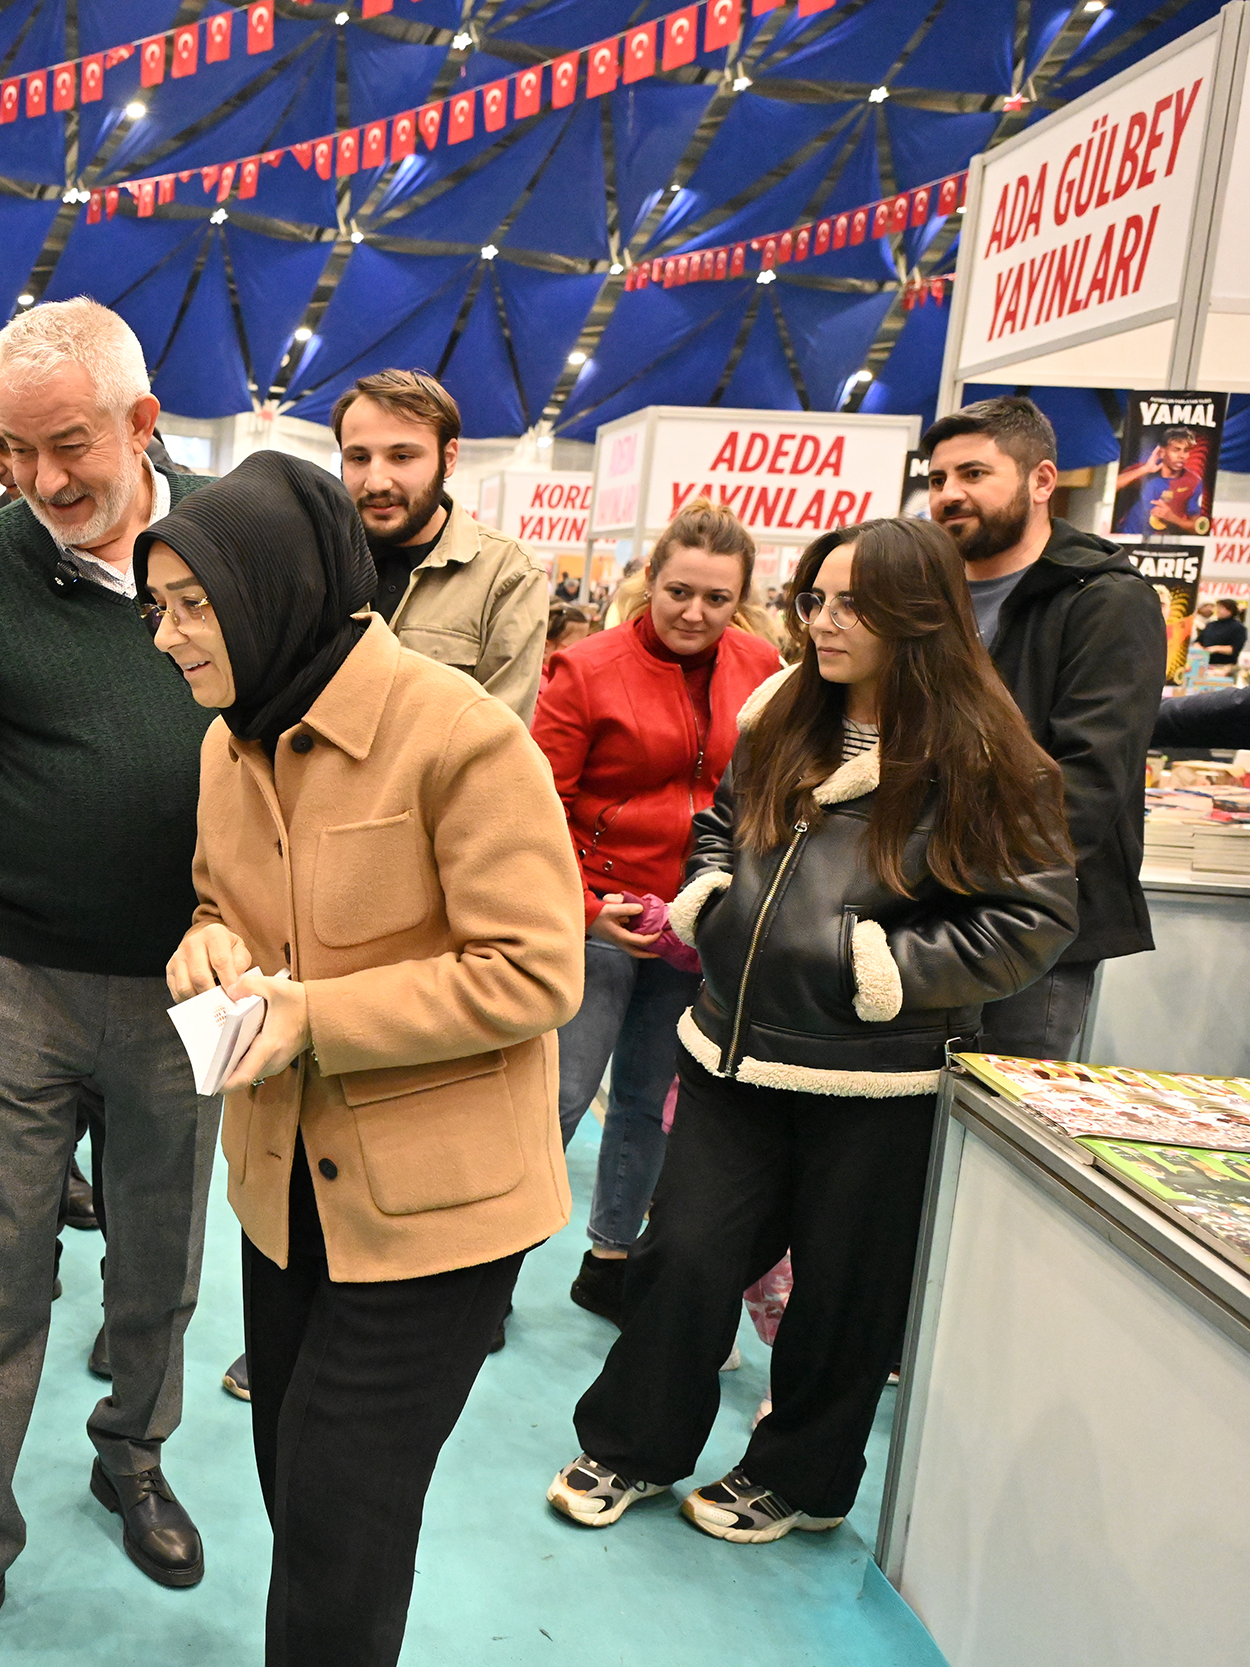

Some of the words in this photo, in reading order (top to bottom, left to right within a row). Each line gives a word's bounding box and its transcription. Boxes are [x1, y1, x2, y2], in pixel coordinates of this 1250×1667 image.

[983, 161, 1049, 260] ADA
[1054, 77, 1204, 226] GÜLBEY
[987, 203, 1162, 342] YAYINLARI
[708, 430, 846, 477] ADEDA
[1139, 401, 1217, 428] YAMAL
